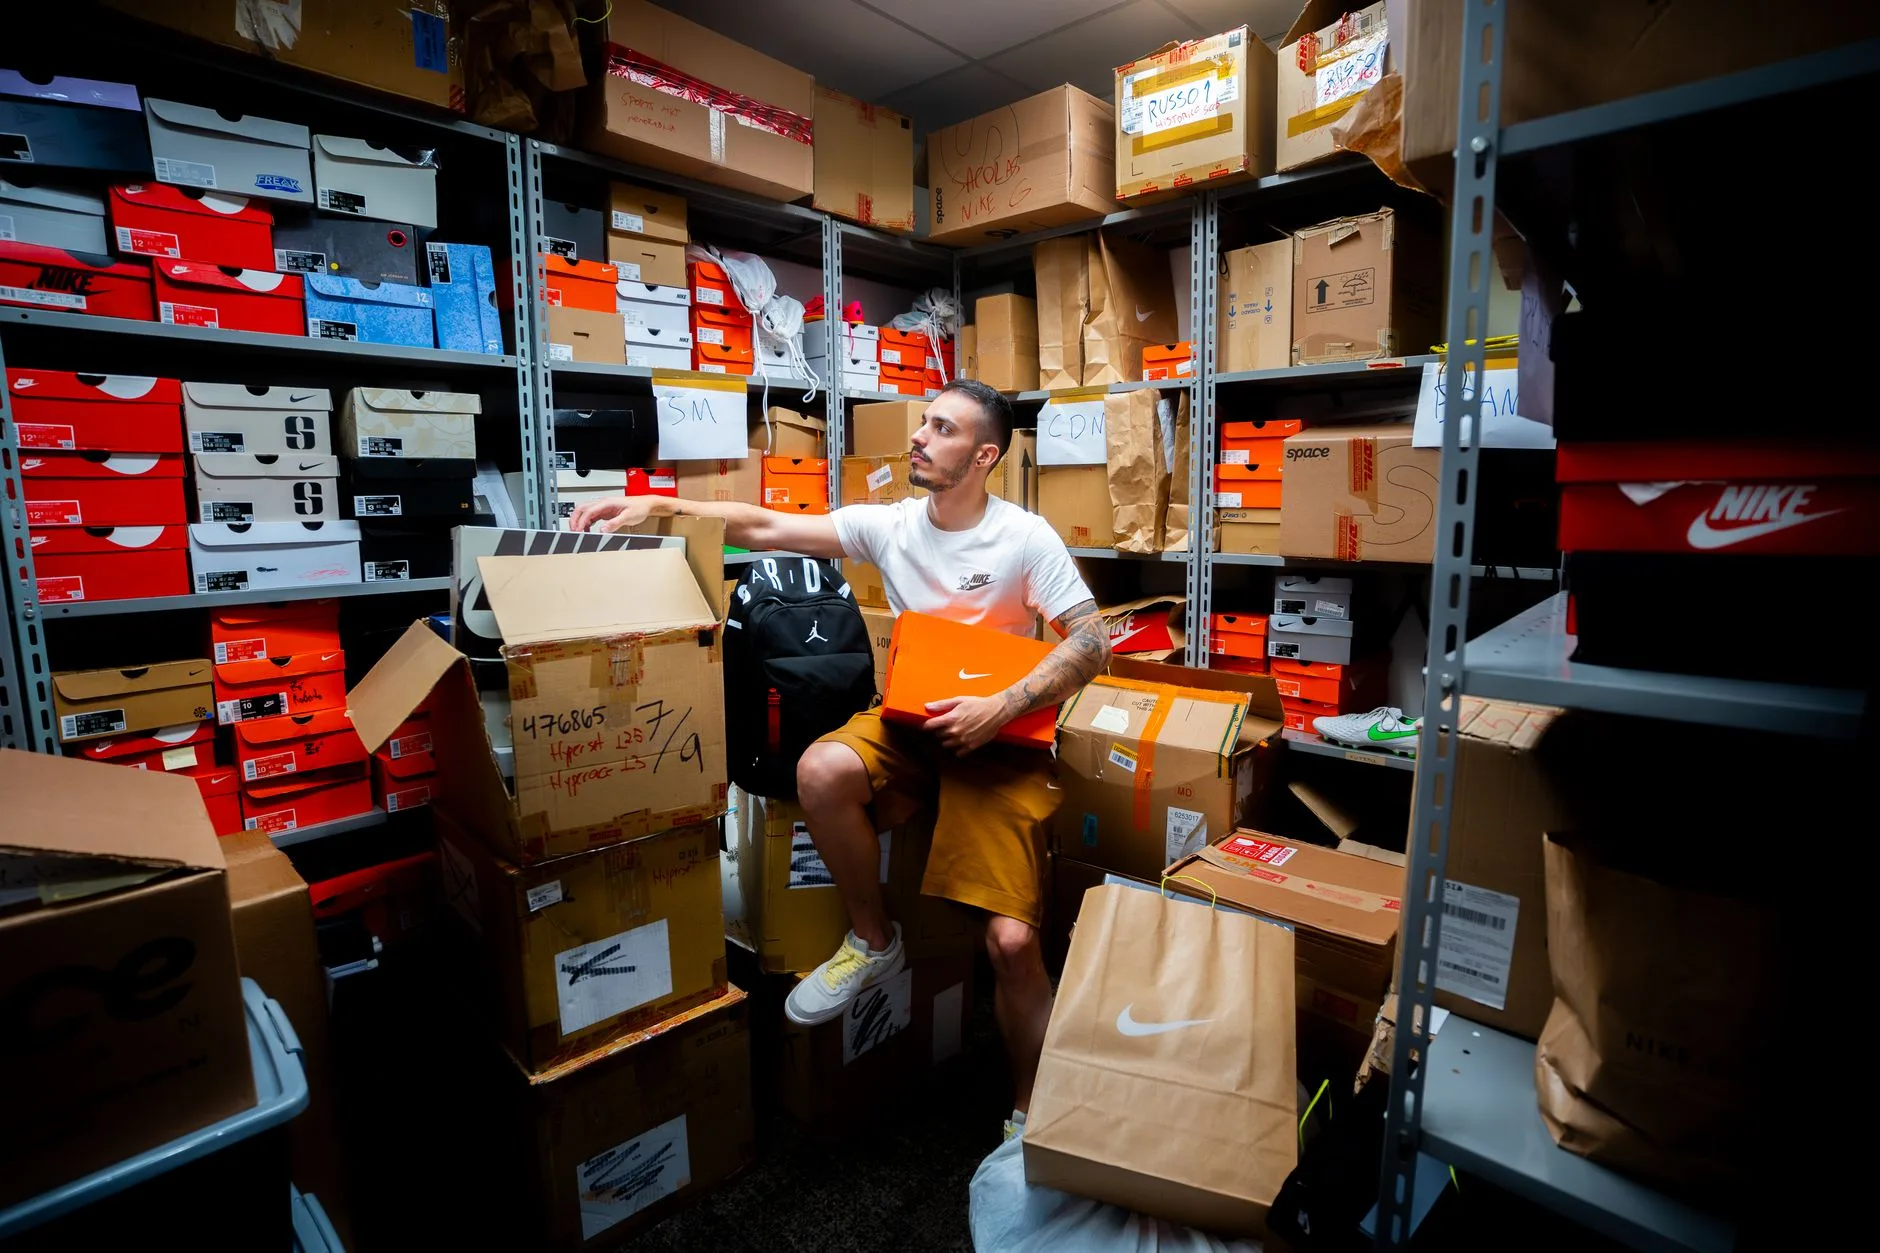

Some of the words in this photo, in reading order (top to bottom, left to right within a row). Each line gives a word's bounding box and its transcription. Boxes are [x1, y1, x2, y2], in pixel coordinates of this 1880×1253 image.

[1148, 86, 1200, 123] RUSSO
[256, 174, 303, 190] FREAK
[935, 187, 946, 224] space
[960, 191, 995, 223] NIKE
[133, 238, 145, 248] 12
[37, 266, 96, 294] NIKE
[174, 313, 186, 323] 11
[1286, 447, 1330, 462] space
[1709, 485, 1818, 521] NIKE
[969, 573, 991, 584] NIKE
[242, 702, 253, 710] 10
[522, 704, 608, 741] 476865
[256, 765, 267, 774] 10
